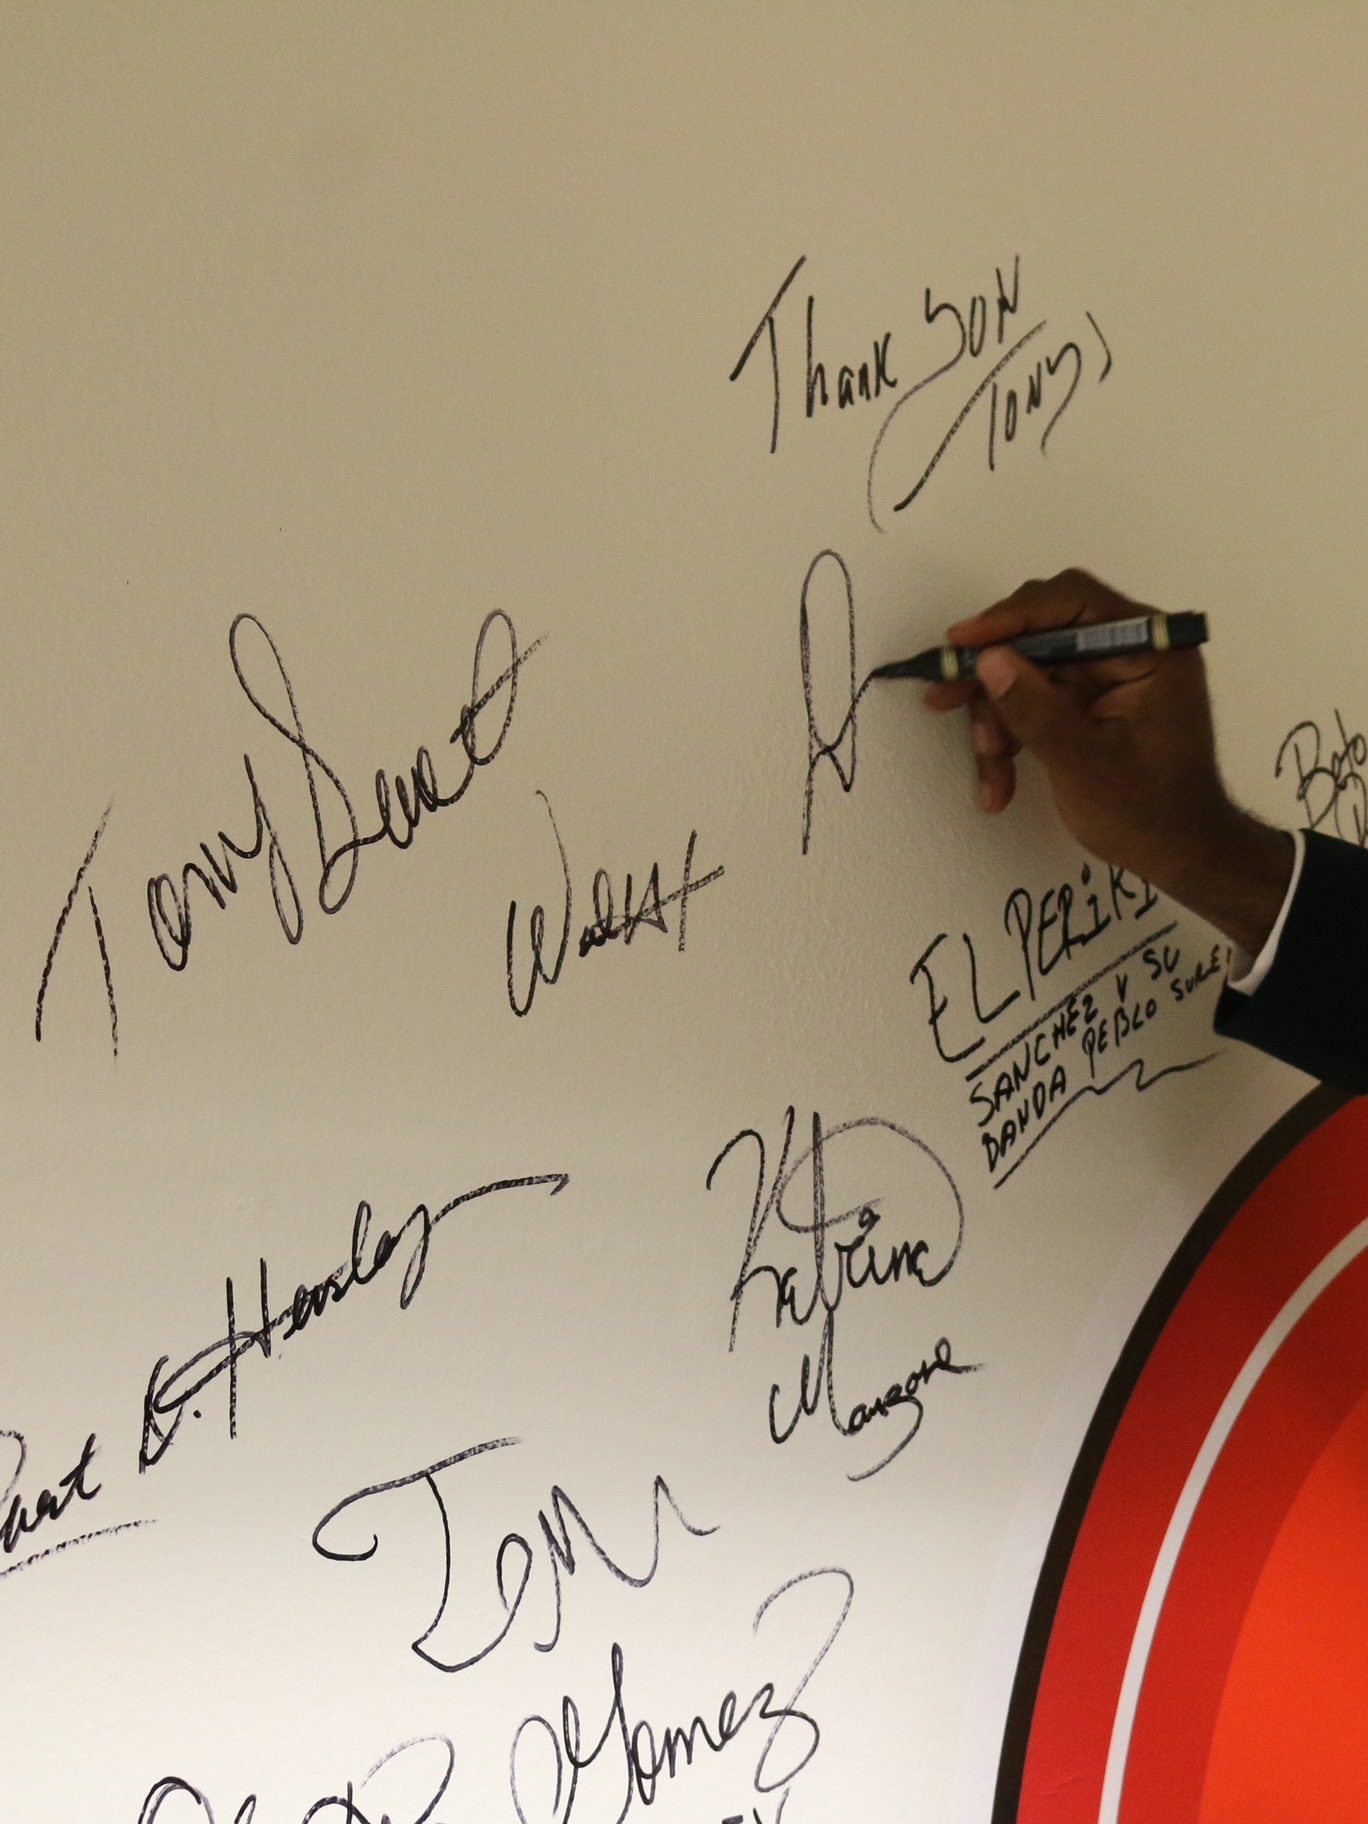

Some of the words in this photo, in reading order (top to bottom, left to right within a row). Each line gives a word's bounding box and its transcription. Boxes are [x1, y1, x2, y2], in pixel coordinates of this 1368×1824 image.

[909, 932, 1021, 1063] EL
[969, 994, 1099, 1128] SANCHEZ
[1142, 945, 1182, 982] SU
